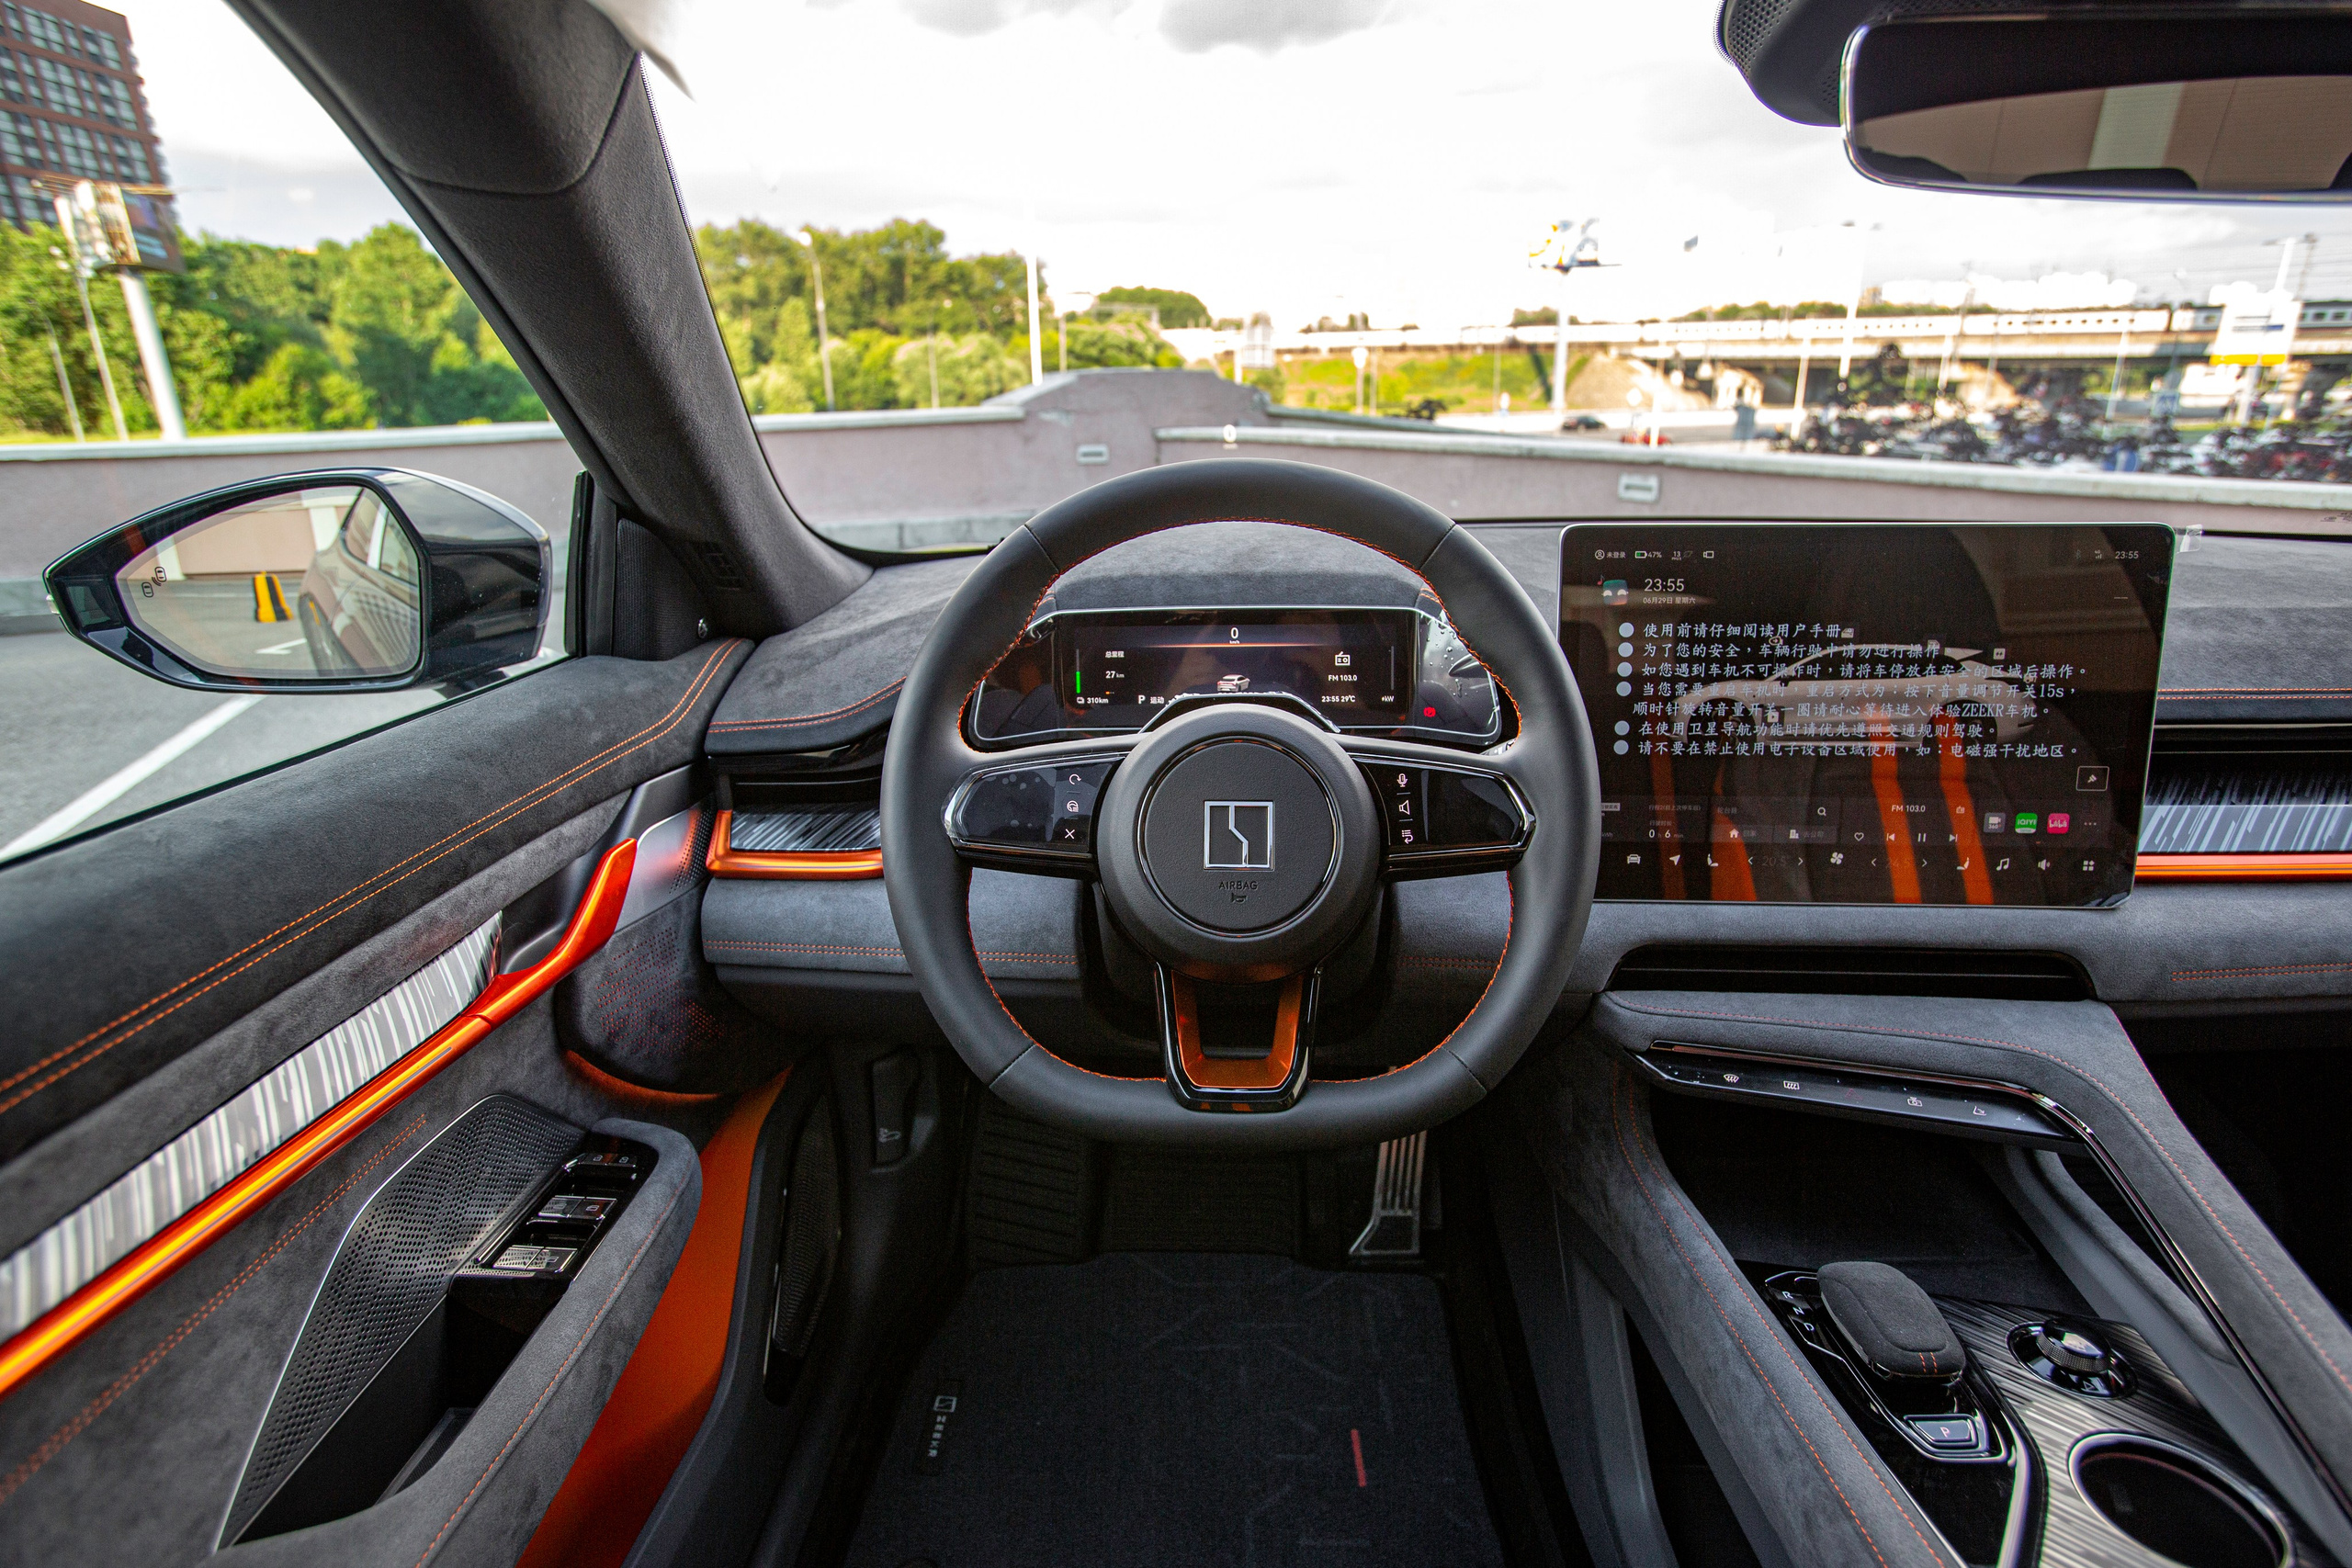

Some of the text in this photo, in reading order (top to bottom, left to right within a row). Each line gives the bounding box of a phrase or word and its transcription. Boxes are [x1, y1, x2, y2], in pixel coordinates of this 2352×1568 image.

[2115, 551, 2139, 559] 23:55
[1644, 579, 1684, 592] 23:55
[1643, 596, 1672, 604] 06月29日
[1230, 626, 1238, 639] 0
[1644, 623, 1841, 638] 使用前请仔细阅读用户手册
[1105, 671, 1115, 679] 27
[1138, 695, 1146, 704] P
[1891, 805, 1927, 813] FM 103.0
[1648, 829, 1656, 838] 0
[1665, 829, 1671, 838] 6
[1218, 880, 1259, 891] AIRBAG
[1782, 1291, 1794, 1300] R
[1792, 1306, 1805, 1315] N
[1804, 1322, 1815, 1332] D
[1939, 1427, 1951, 1438] P
